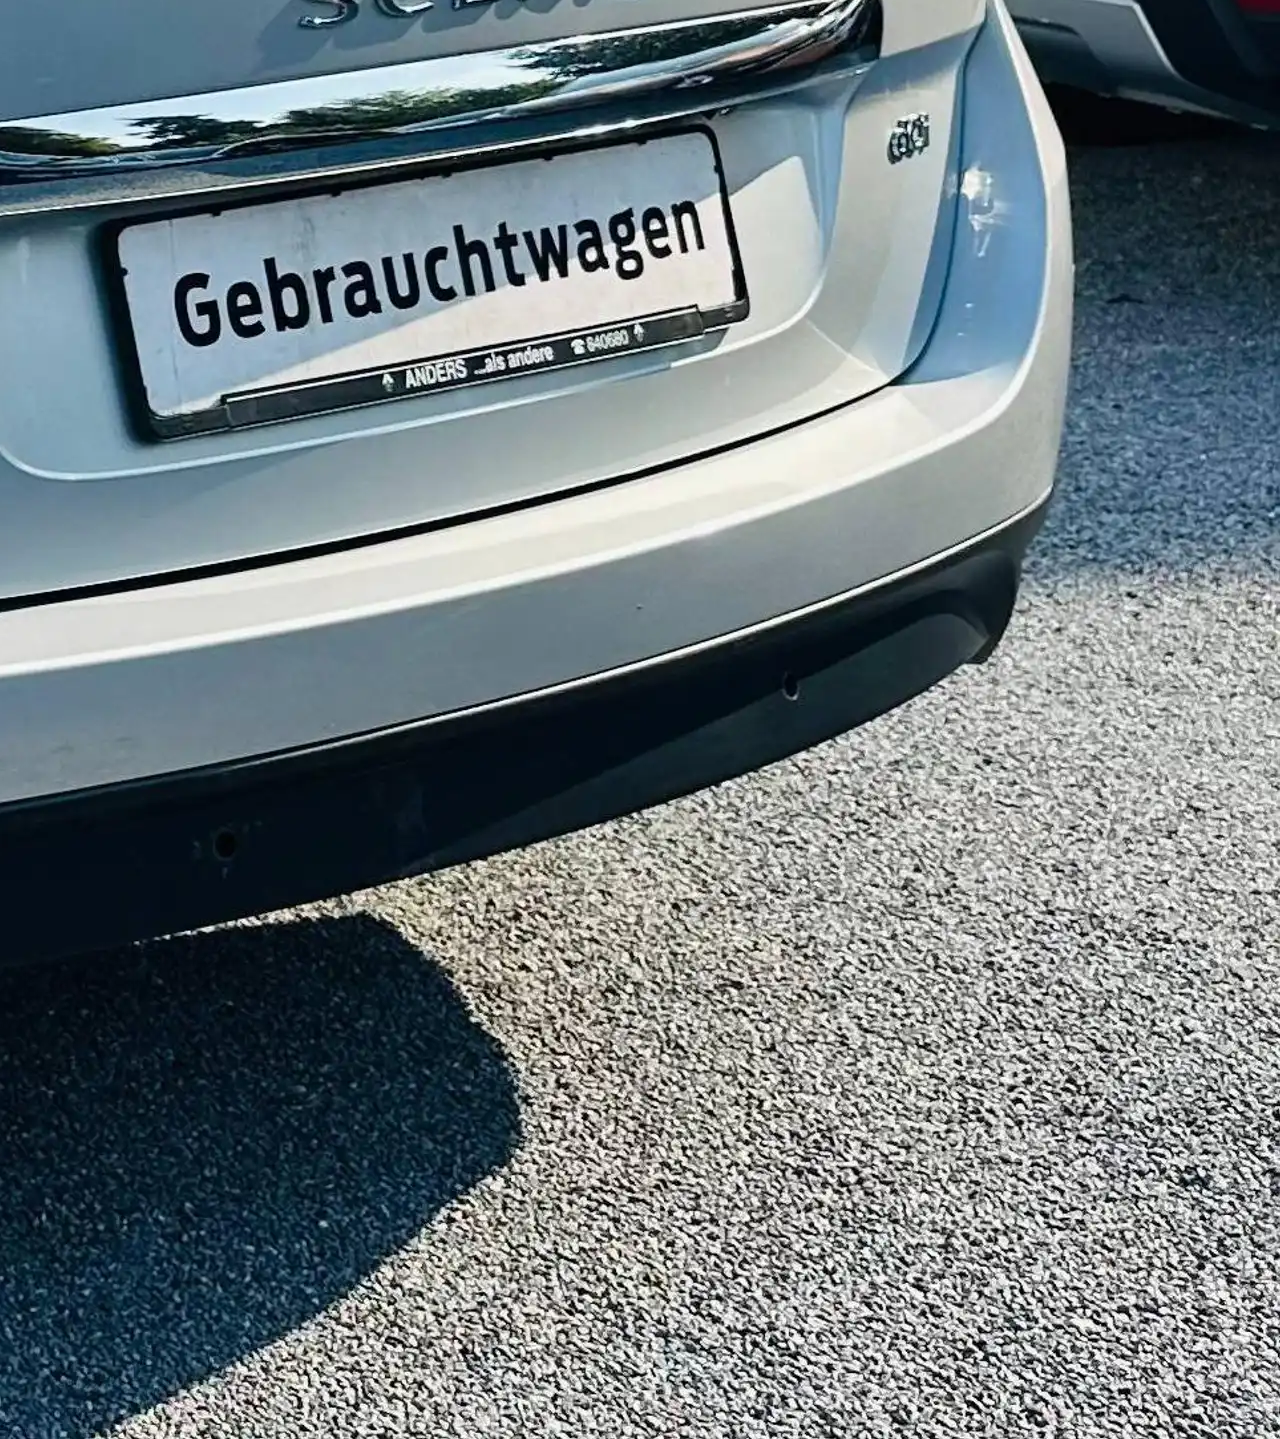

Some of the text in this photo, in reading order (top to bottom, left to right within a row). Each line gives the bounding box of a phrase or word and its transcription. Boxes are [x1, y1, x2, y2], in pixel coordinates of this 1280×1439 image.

[173, 200, 706, 348] Gebrauchtwagen
[405, 359, 468, 389] ANDERS
[507, 344, 554, 370] andere
